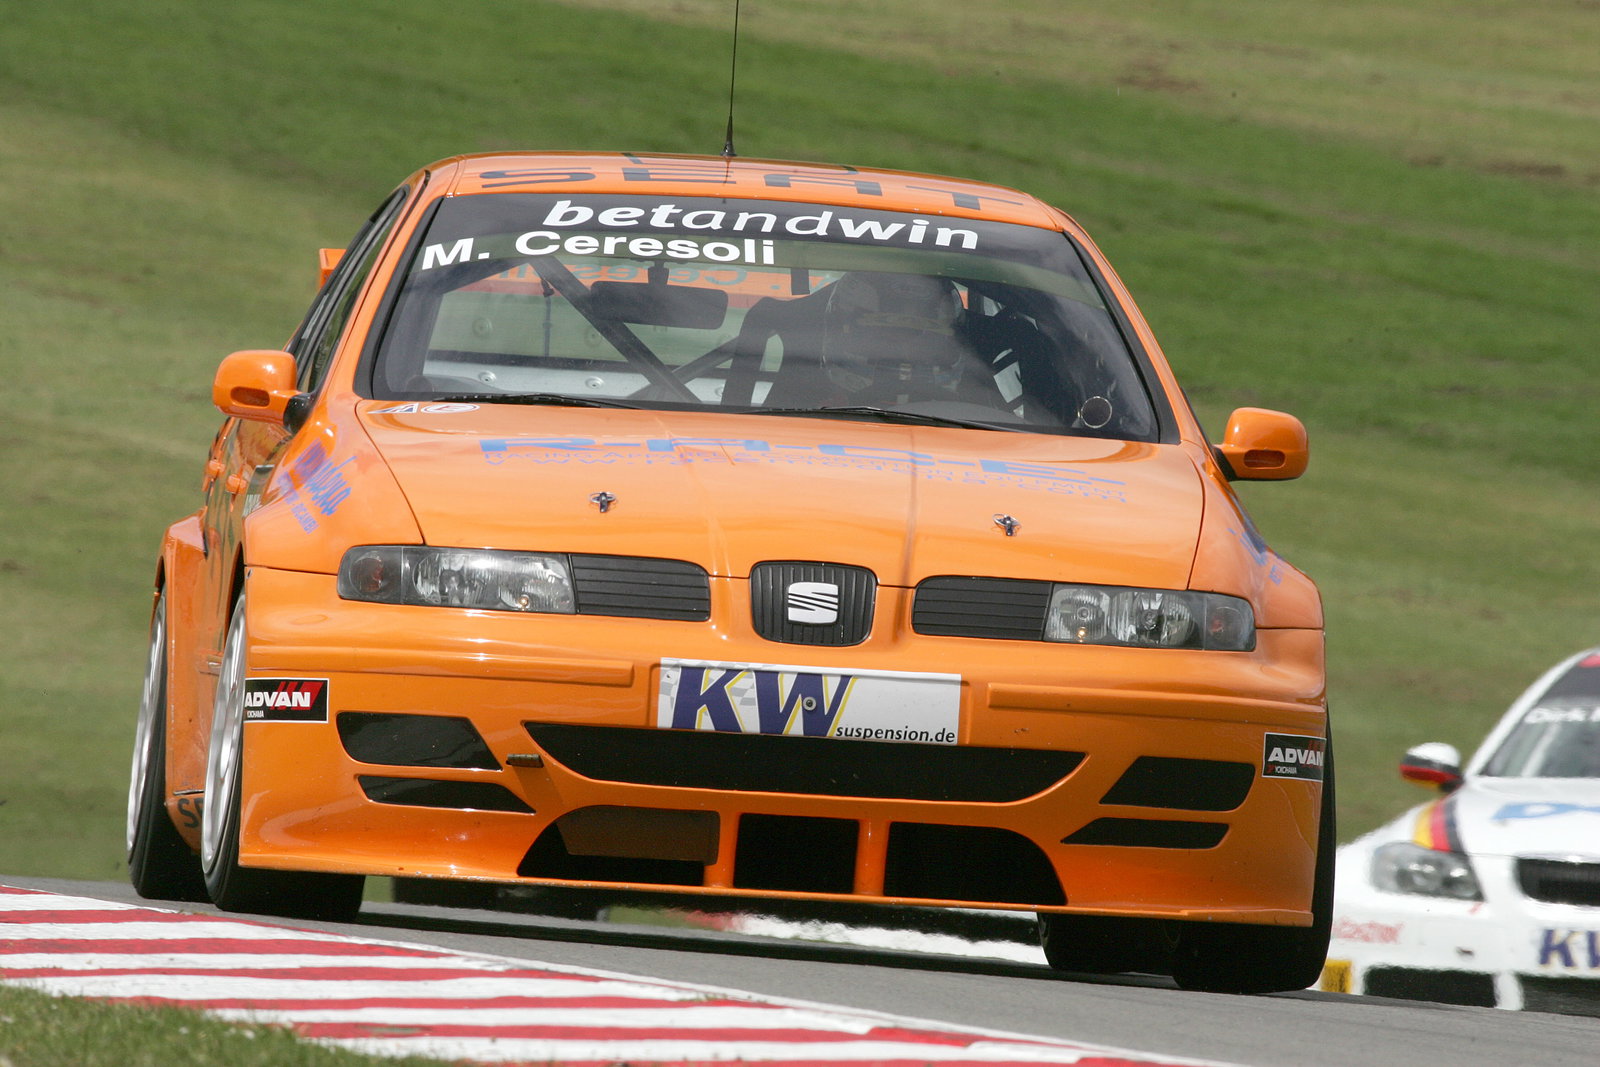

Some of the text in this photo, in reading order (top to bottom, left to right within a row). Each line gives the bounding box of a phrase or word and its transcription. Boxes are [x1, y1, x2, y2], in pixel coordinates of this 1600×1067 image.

[480, 166, 1023, 210] SEAT
[542, 199, 978, 250] betandwin
[421, 230, 775, 271] M. Ceresoli
[245, 691, 311, 708] ADVAN
[671, 665, 858, 738] KW
[836, 725, 956, 744] suspension.de
[1268, 746, 1323, 767] ADVAN
